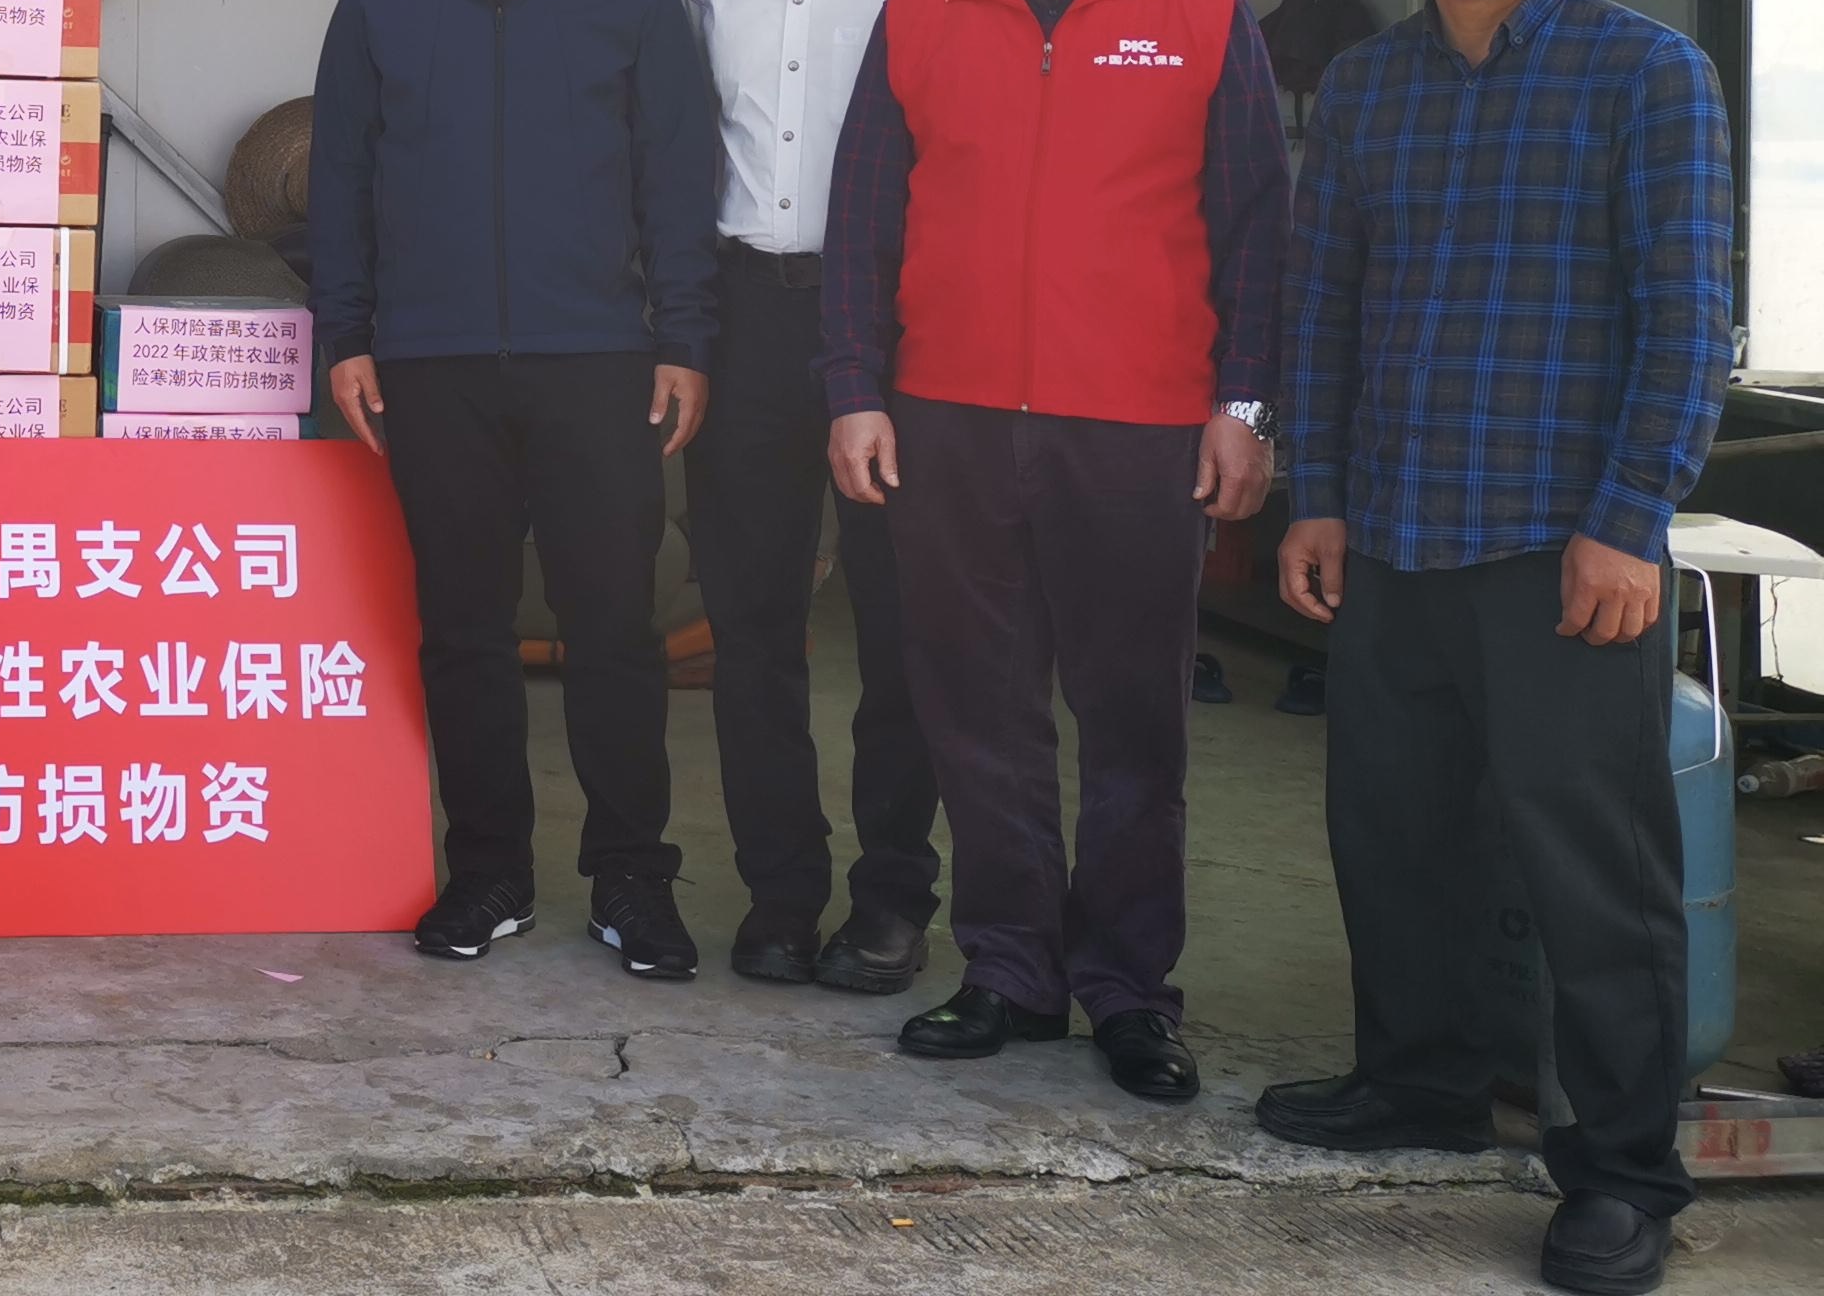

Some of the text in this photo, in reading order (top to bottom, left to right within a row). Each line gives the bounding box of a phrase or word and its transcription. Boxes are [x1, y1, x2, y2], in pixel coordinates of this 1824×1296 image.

[1119, 39, 1158, 53] PICC
[1093, 54, 1184, 67] 中国人民保险
[133, 315, 298, 340] 人保财险番禺支公司
[131, 368, 297, 391] 险寒潮灾后防损物资
